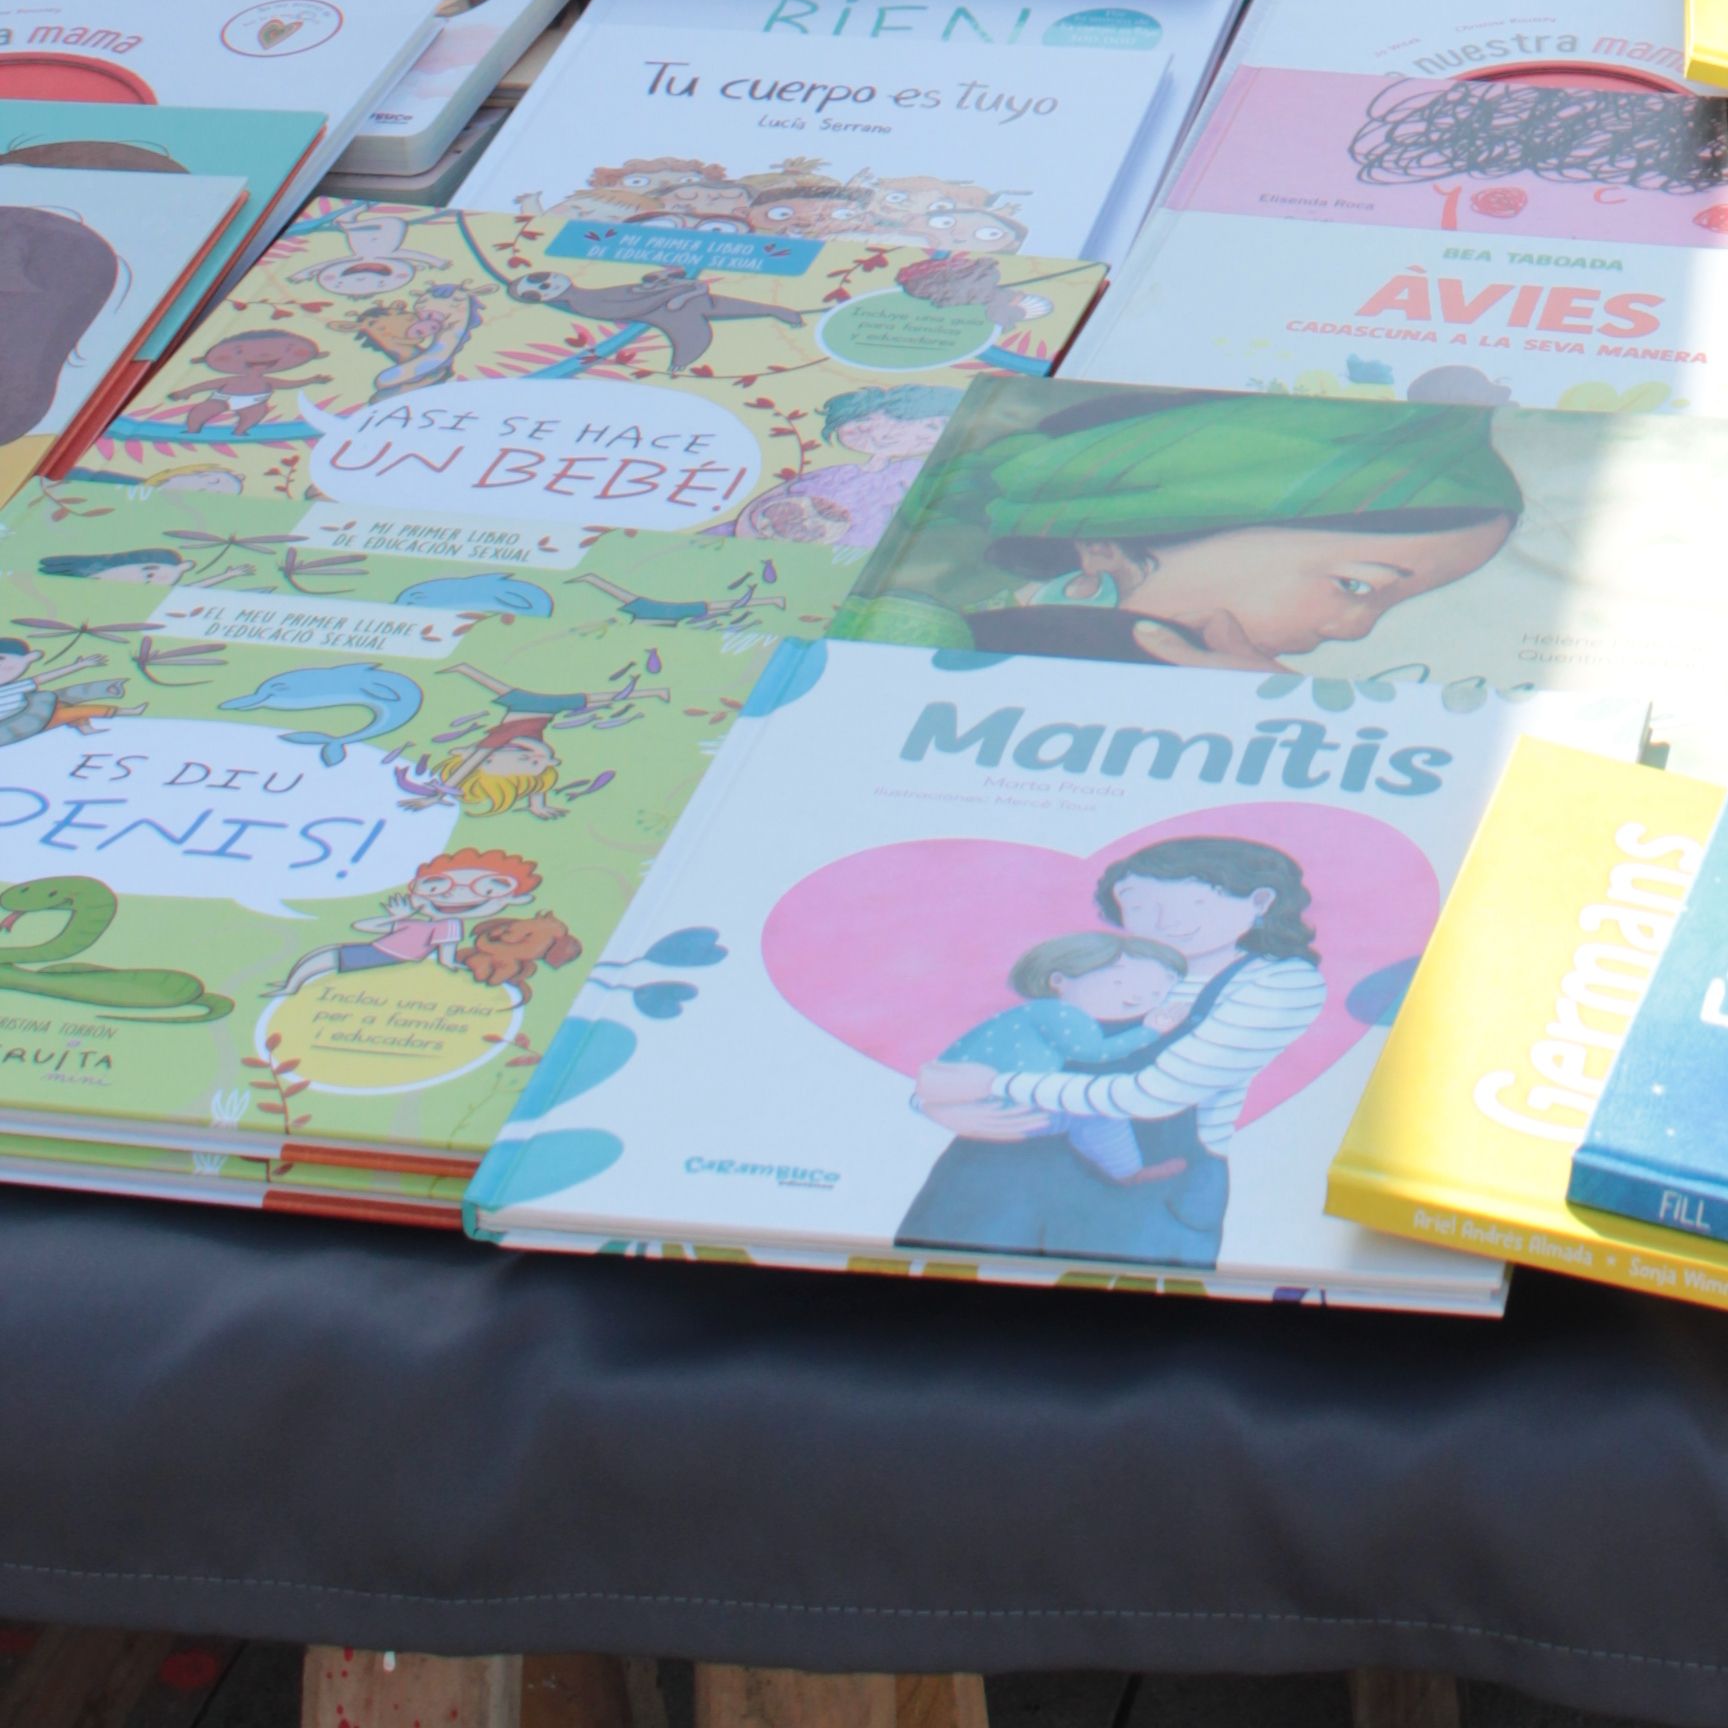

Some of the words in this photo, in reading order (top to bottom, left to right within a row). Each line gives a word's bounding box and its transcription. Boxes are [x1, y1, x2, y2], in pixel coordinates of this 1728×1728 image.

[1412, 29, 1579, 79] nuestra
[1590, 33, 1688, 71] mam
[644, 60, 699, 98] Tu
[719, 76, 877, 114] cuerpo
[888, 81, 942, 110] es
[955, 80, 1060, 124] tuyo
[819, 117, 892, 135] Serrano
[1258, 192, 1329, 209] Elisenda
[1333, 198, 1376, 212] Roca
[618, 233, 643, 246] MI
[645, 236, 703, 252] PRIMER
[706, 240, 756, 257] LIBRO
[1442, 247, 1492, 264] BEA
[1506, 251, 1625, 272] TABOADA
[699, 255, 765, 272] SEXUAL
[1354, 264, 1667, 340] ÀVIES
[1285, 319, 1439, 344] CADASCUNA
[1449, 332, 1468, 345] A
[1478, 334, 1512, 349] LA
[1523, 338, 1587, 355] SEVA
[1595, 343, 1708, 364] MANERA
[498, 415, 562, 439] SE
[575, 423, 718, 455] HACE
[329, 439, 466, 478] UN
[470, 447, 748, 513] BEBÉ!
[369, 520, 396, 535] MI
[398, 523, 463, 540] PRIMER
[466, 528, 521, 545] LIBRO
[331, 533, 361, 549] DE
[364, 533, 463, 558] EDUCACIÓN
[466, 542, 532, 563] SEXUAL
[203, 607, 229, 621] EL
[238, 608, 280, 626] MEU
[283, 611, 349, 632] PRIMER
[353, 616, 419, 638] LLIBRE
[319, 629, 389, 651] SEXUAL
[898, 701, 1456, 799] Mamitis
[68, 752, 150, 782] ES
[162, 760, 305, 795] DIU
[983, 774, 1052, 795] Marta
[1057, 779, 1127, 801] Prada
[313, 985, 390, 1010] Inclou
[396, 995, 440, 1013] una
[311, 1008, 355, 1027] per
[362, 1013, 378, 1025] a
[326, 1028, 446, 1053] educadors
[1413, 1209, 1457, 1234] Ariel
[1462, 1219, 1524, 1250] Andrés
[1528, 1236, 1593, 1268] Almada
[1628, 1255, 1677, 1286] Sonja
